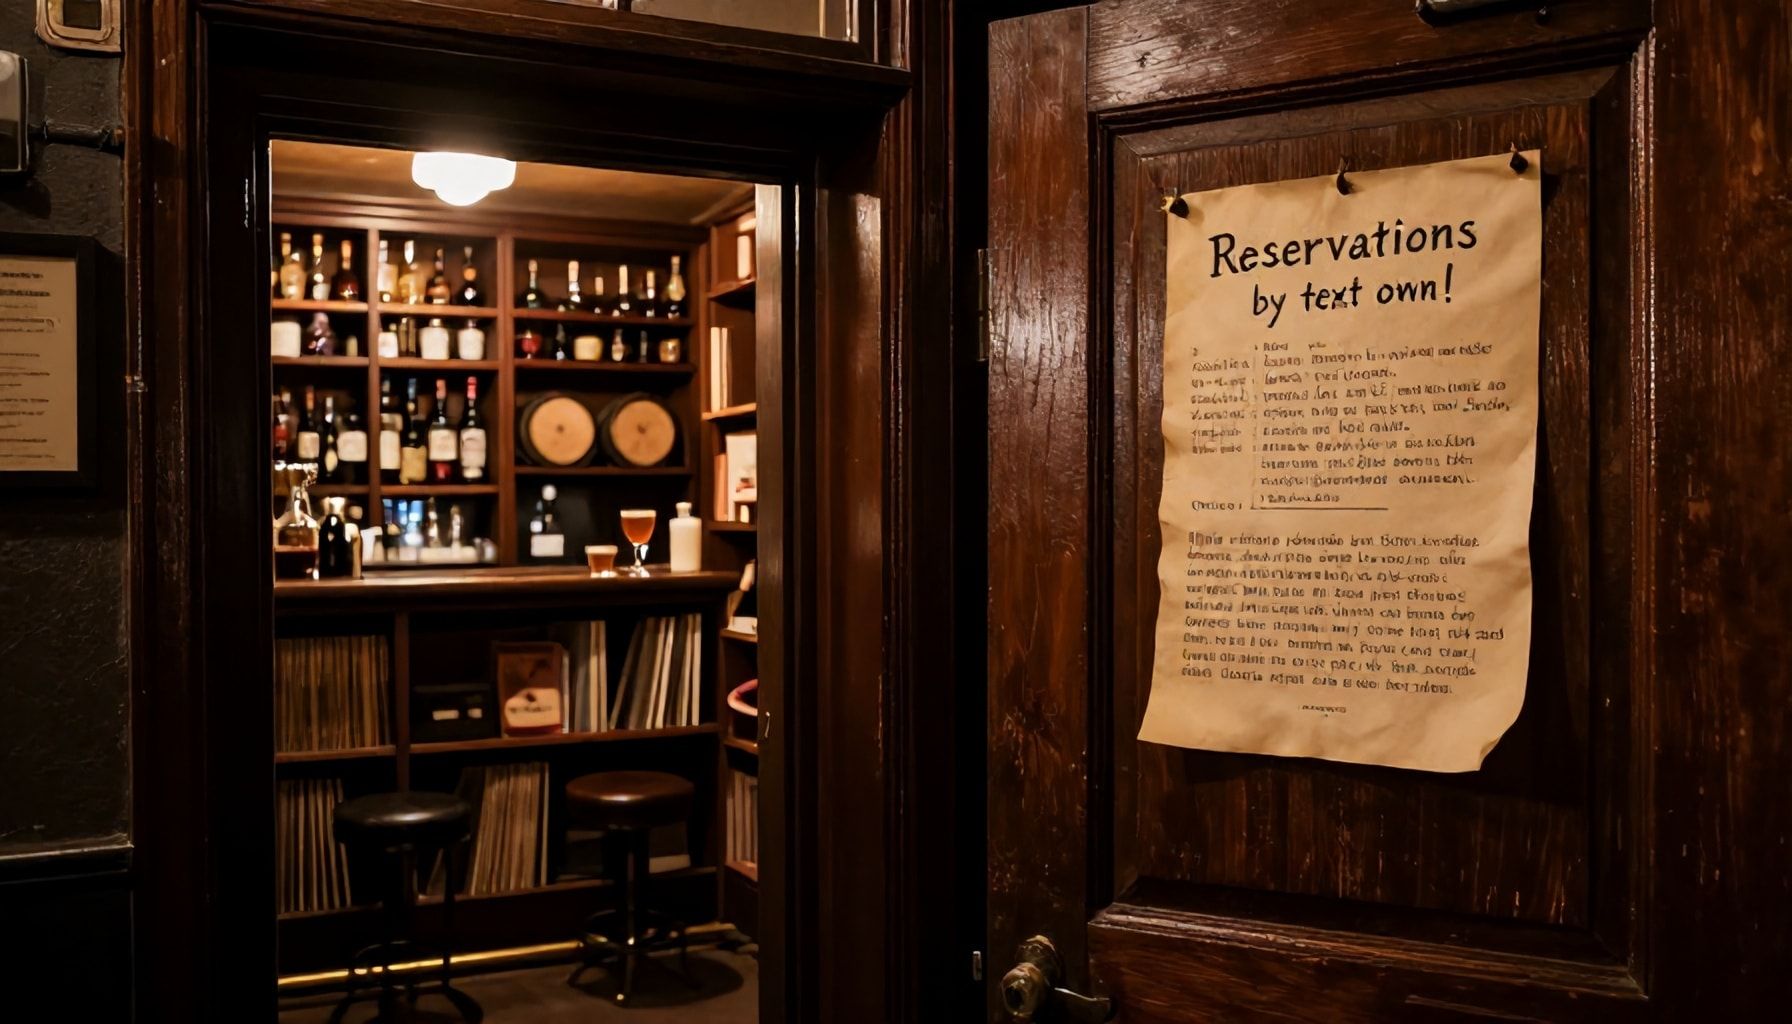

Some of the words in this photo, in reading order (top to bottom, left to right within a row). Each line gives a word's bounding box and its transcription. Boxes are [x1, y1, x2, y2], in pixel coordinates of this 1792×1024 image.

[1209, 219, 1479, 278] Reservations
[1253, 284, 1287, 328] by
[1301, 277, 1363, 311] text
[1377, 263, 1453, 305] own!
